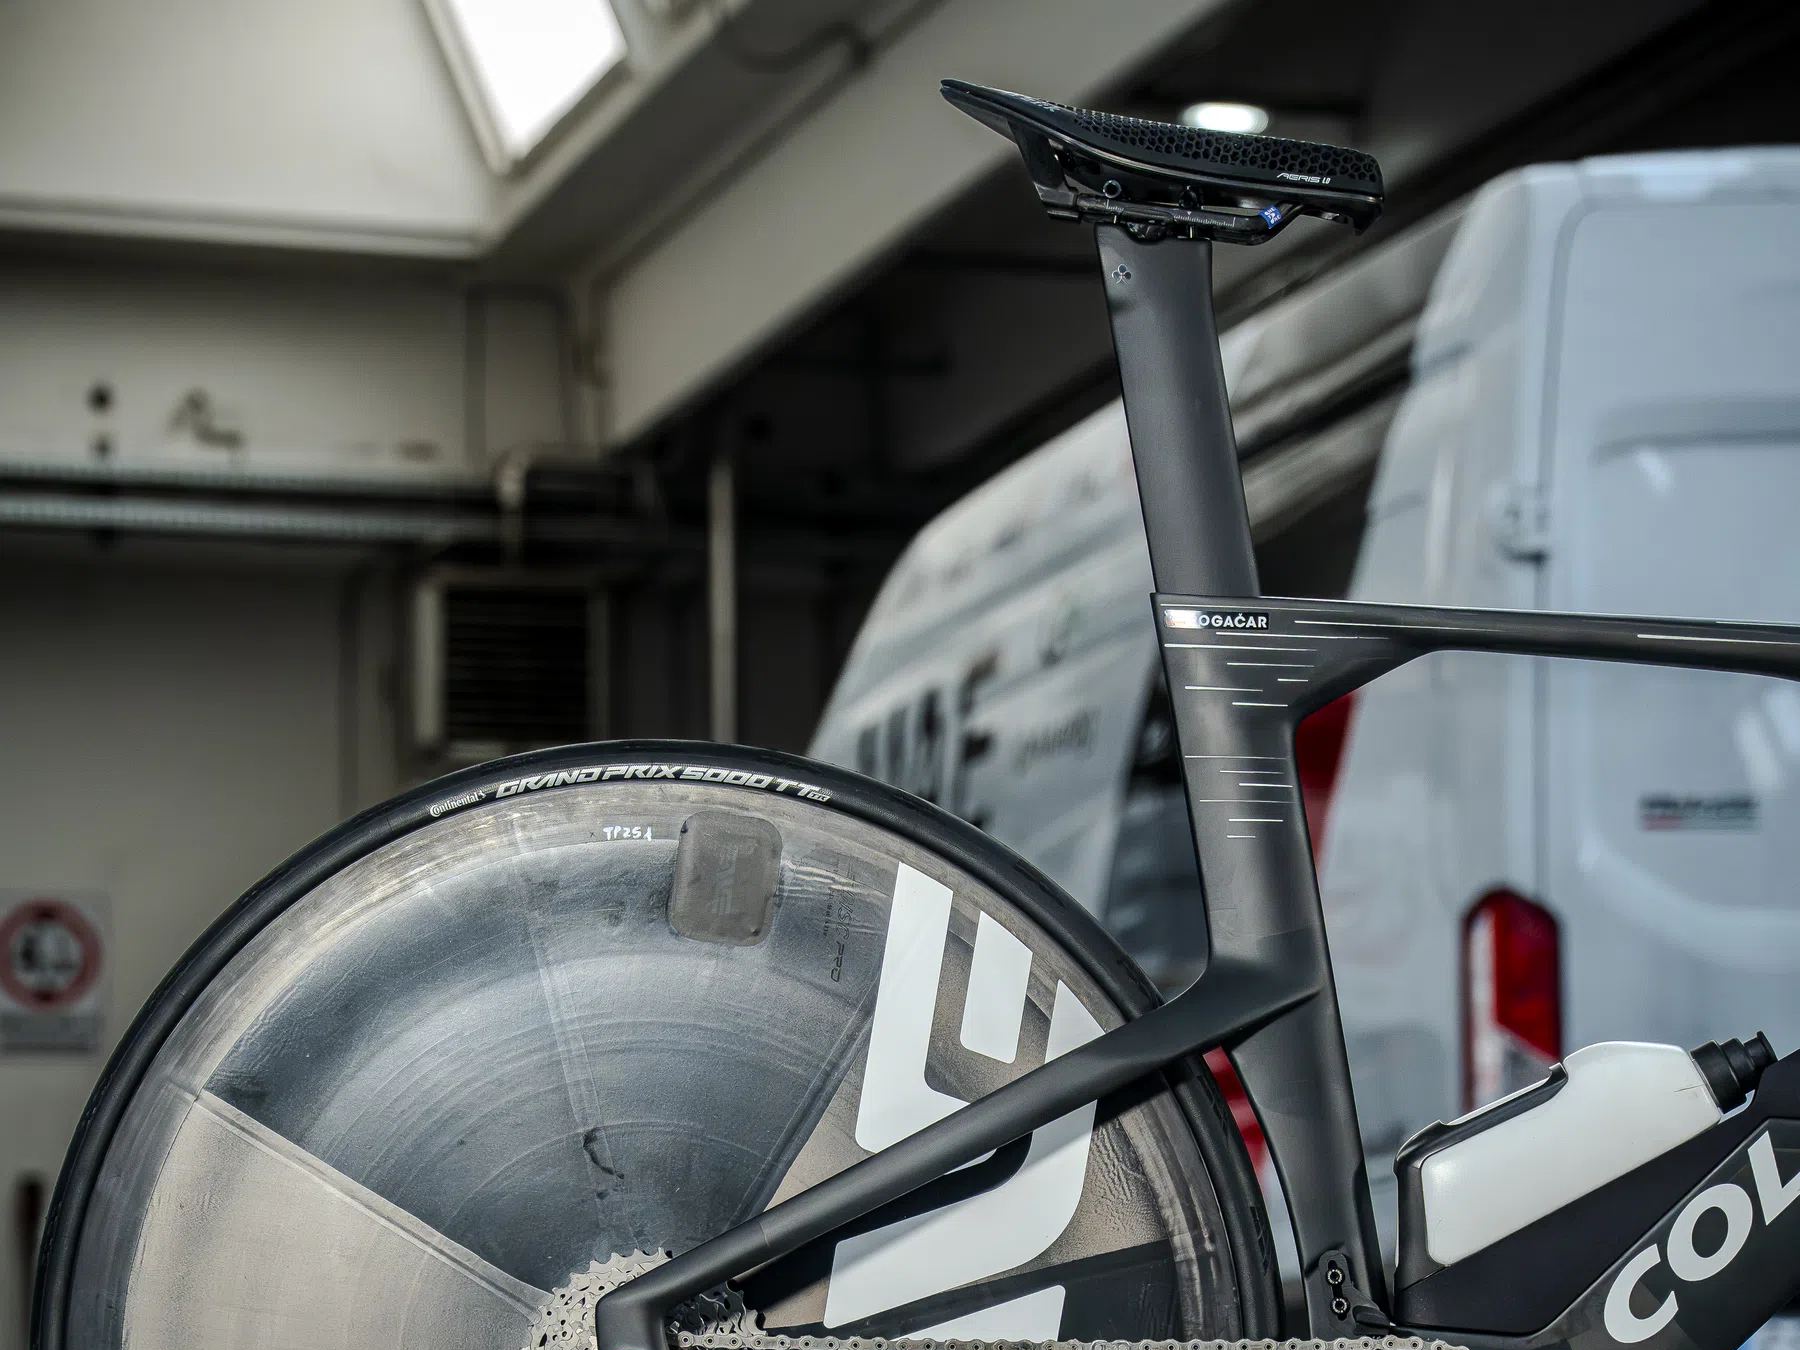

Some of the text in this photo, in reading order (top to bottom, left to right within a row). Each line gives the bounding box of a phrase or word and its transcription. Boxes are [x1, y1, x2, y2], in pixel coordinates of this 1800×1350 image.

[1276, 172, 1321, 184] AERIS
[1197, 612, 1268, 629] OGAČAR
[429, 793, 480, 818] Continental
[495, 767, 603, 799] GRAND
[601, 764, 682, 781] PRIX
[679, 766, 775, 789] 5000
[772, 777, 821, 797] TT
[1603, 1130, 1800, 1345] COL
